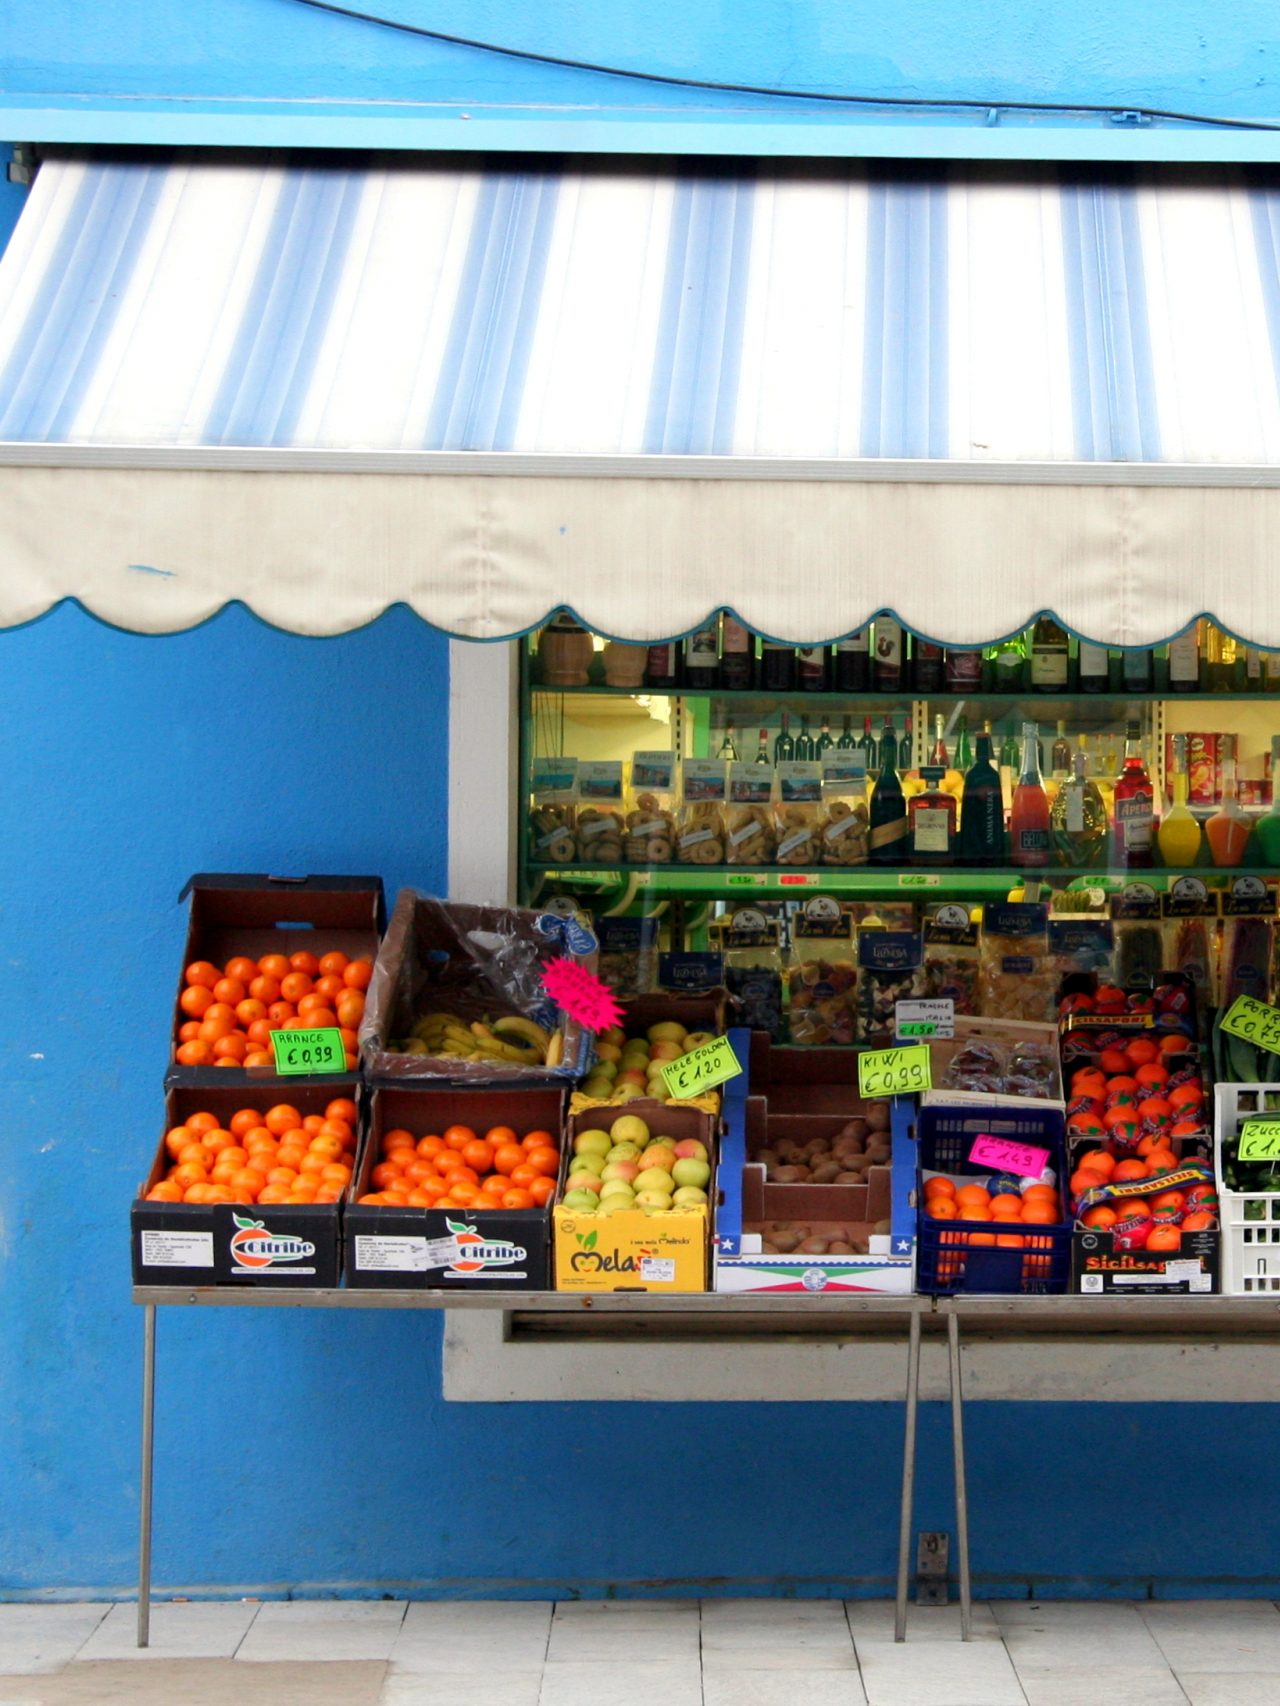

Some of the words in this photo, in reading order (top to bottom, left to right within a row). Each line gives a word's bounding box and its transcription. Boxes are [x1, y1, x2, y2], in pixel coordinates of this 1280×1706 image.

[1121, 802, 1153, 817] APERO
[278, 1033, 325, 1044] ARANCE
[287, 1048, 298, 1065] €
[302, 1046, 333, 1065] 0,99
[864, 1051, 904, 1069] KIWI
[665, 1056, 692, 1076] MELE
[883, 1064, 923, 1090] 0,99
[246, 1241, 313, 1255] Citribe
[460, 1246, 526, 1259] Citribe
